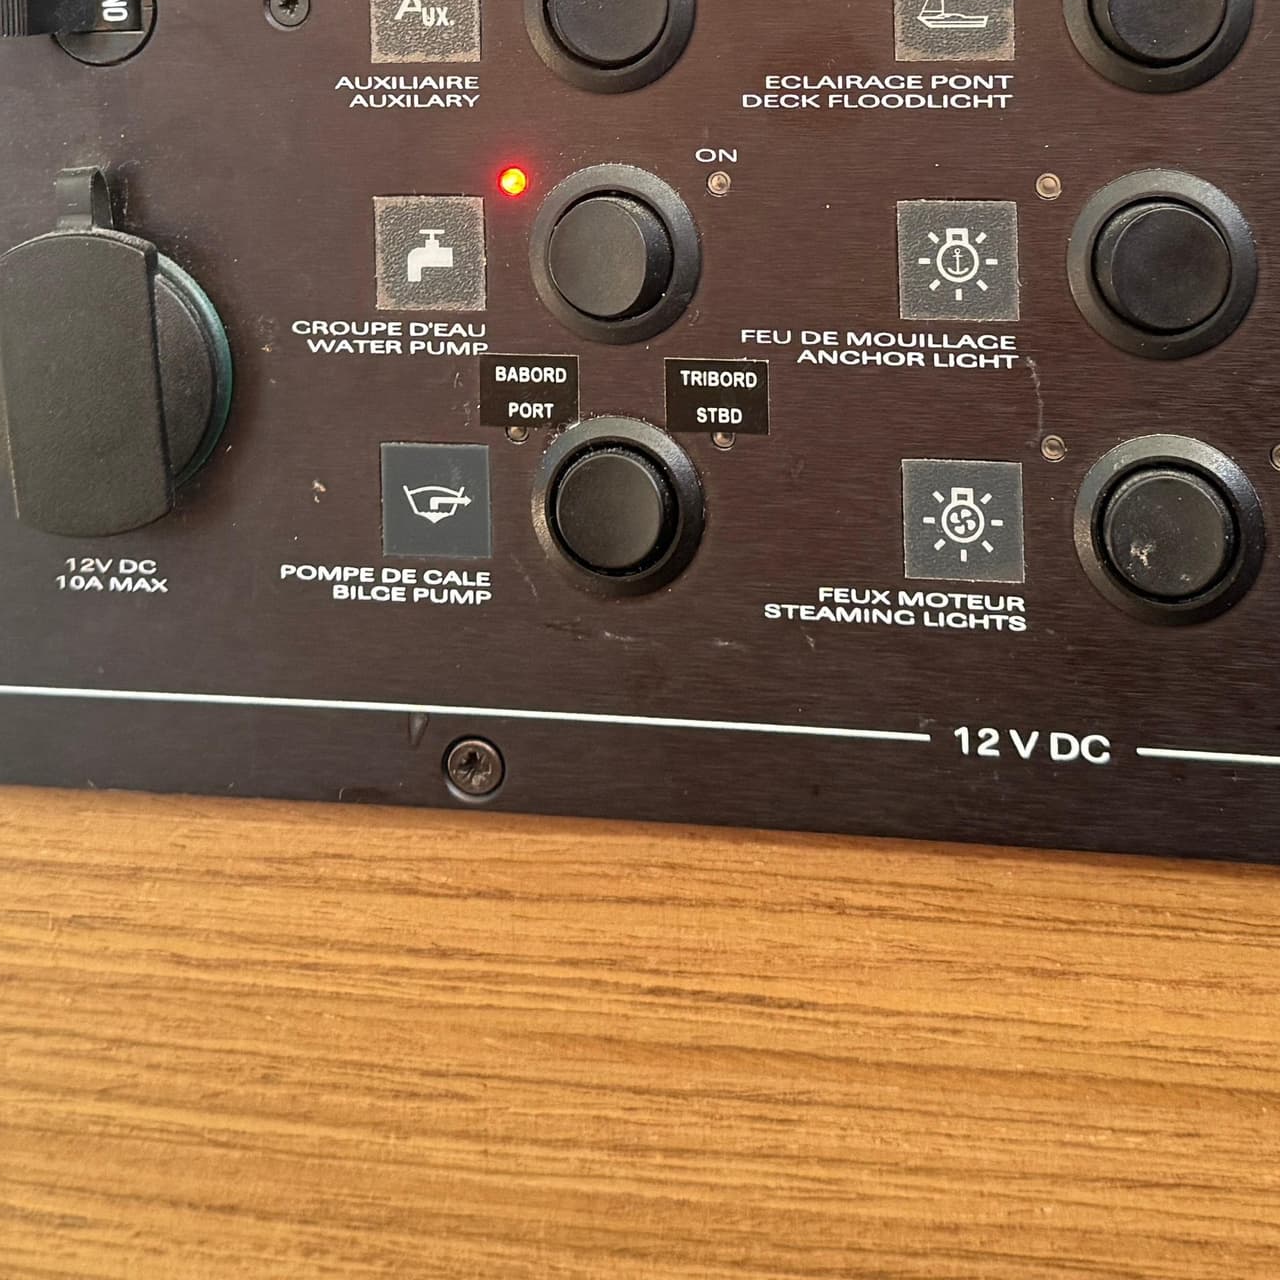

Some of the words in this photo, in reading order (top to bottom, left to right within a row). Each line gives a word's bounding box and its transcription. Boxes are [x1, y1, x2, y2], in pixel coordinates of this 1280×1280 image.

[334, 75, 480, 90] AUXILIAIRE
[765, 74, 924, 90] ECLAIRAGE
[931, 74, 1014, 90] PONT
[348, 93, 481, 108] AUXILARY
[742, 93, 821, 109] DECK
[828, 93, 1014, 109] FLOODLIGHT
[695, 148, 738, 163] ON
[409, 322, 486, 338] D'EAU
[306, 338, 403, 355] WATER
[409, 339, 489, 357] PUMP
[741, 329, 792, 345] FEU
[801, 330, 839, 346] DE
[846, 331, 1017, 351] MOUILLAGE
[796, 349, 926, 367] ANCHOR
[933, 352, 1020, 369] LIGHT
[495, 365, 567, 384] BABORD
[679, 369, 758, 388] TRIBORD
[508, 401, 555, 419] PORT
[696, 407, 743, 424] STBD
[65, 557, 113, 574] 12V
[119, 558, 157, 575] DC
[56, 575, 104, 591] 10A
[109, 576, 169, 593] MAX
[280, 564, 375, 583] POMPE
[381, 567, 417, 584] DE
[420, 569, 491, 590] CALE
[413, 587, 492, 605] PUMP
[818, 586, 892, 605] FEUX
[897, 591, 1026, 612] MOTEUR
[953, 726, 1000, 757] 12
[1009, 729, 1040, 759] V
[1049, 732, 1111, 764] DC
